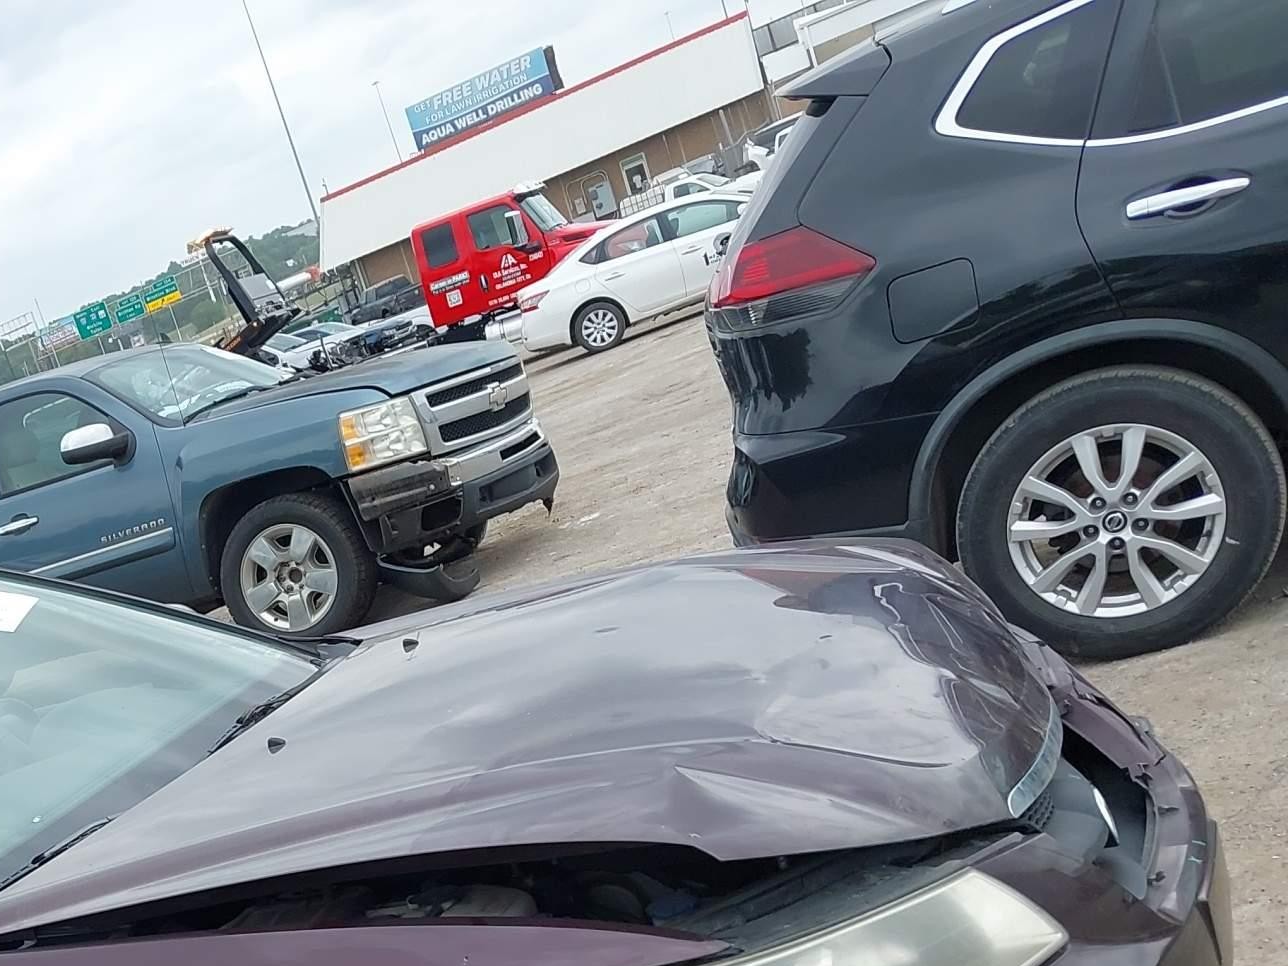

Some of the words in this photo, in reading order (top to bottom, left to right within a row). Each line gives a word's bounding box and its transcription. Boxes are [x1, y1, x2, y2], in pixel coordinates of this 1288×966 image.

[414, 100, 431, 113] GET
[432, 82, 472, 110] FREE
[475, 55, 532, 91] WATER
[425, 110, 444, 125] FOR
[445, 98, 472, 117] LAWN
[472, 72, 528, 104] IRRIGATION
[421, 122, 455, 146] AQUA
[454, 109, 487, 130] WELL
[487, 83, 544, 117] DRILLING
[100, 517, 165, 543] SILVERADO
